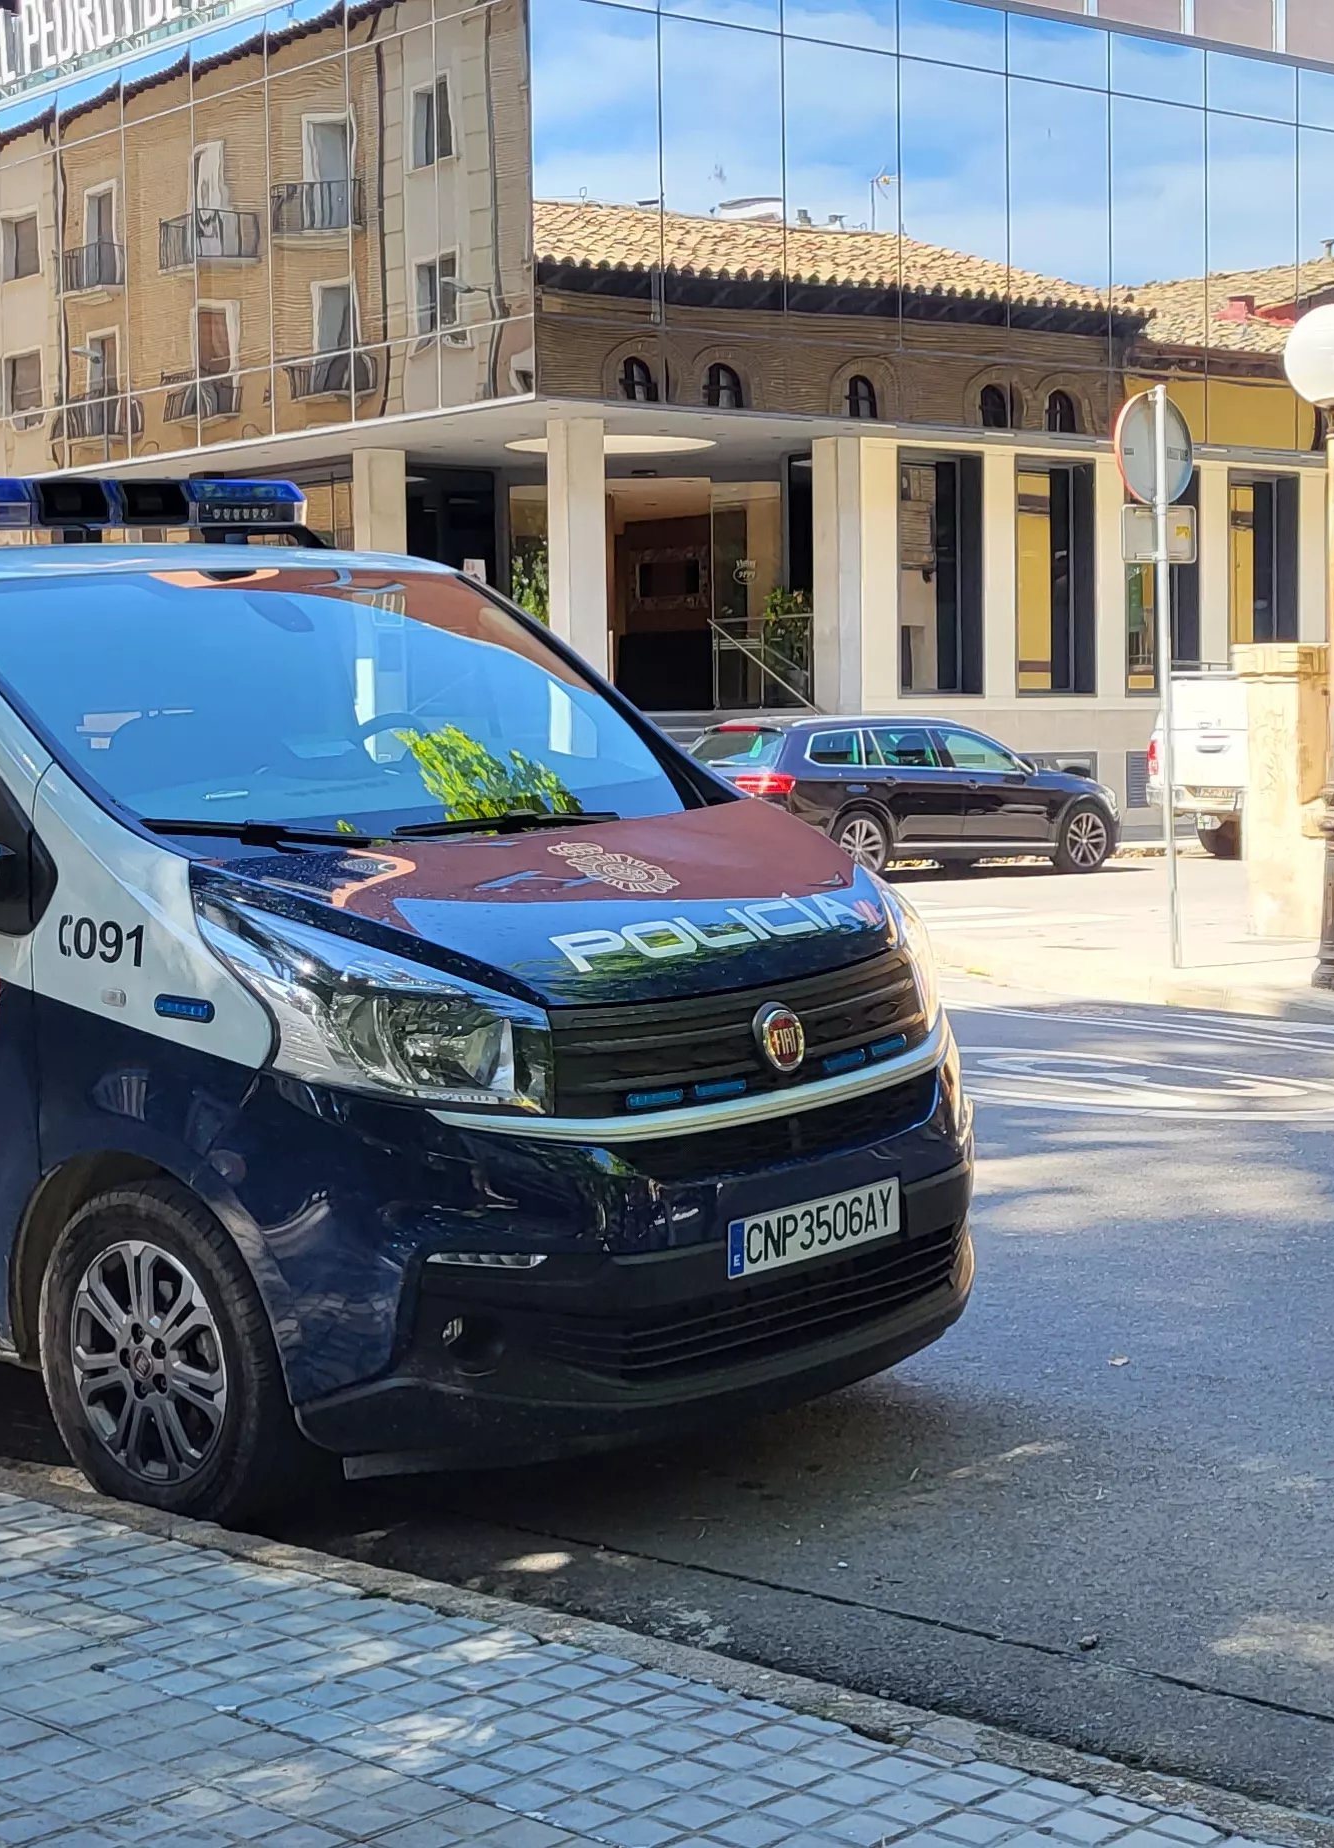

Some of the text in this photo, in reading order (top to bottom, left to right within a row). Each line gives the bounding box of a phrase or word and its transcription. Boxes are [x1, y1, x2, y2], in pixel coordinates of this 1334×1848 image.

[73, 916, 145, 968] 091
[548, 891, 868, 973] POLICÍA
[773, 1026, 797, 1056] FIAT
[746, 1186, 893, 1265] CNP3506AY
[733, 1253, 741, 1268] E
